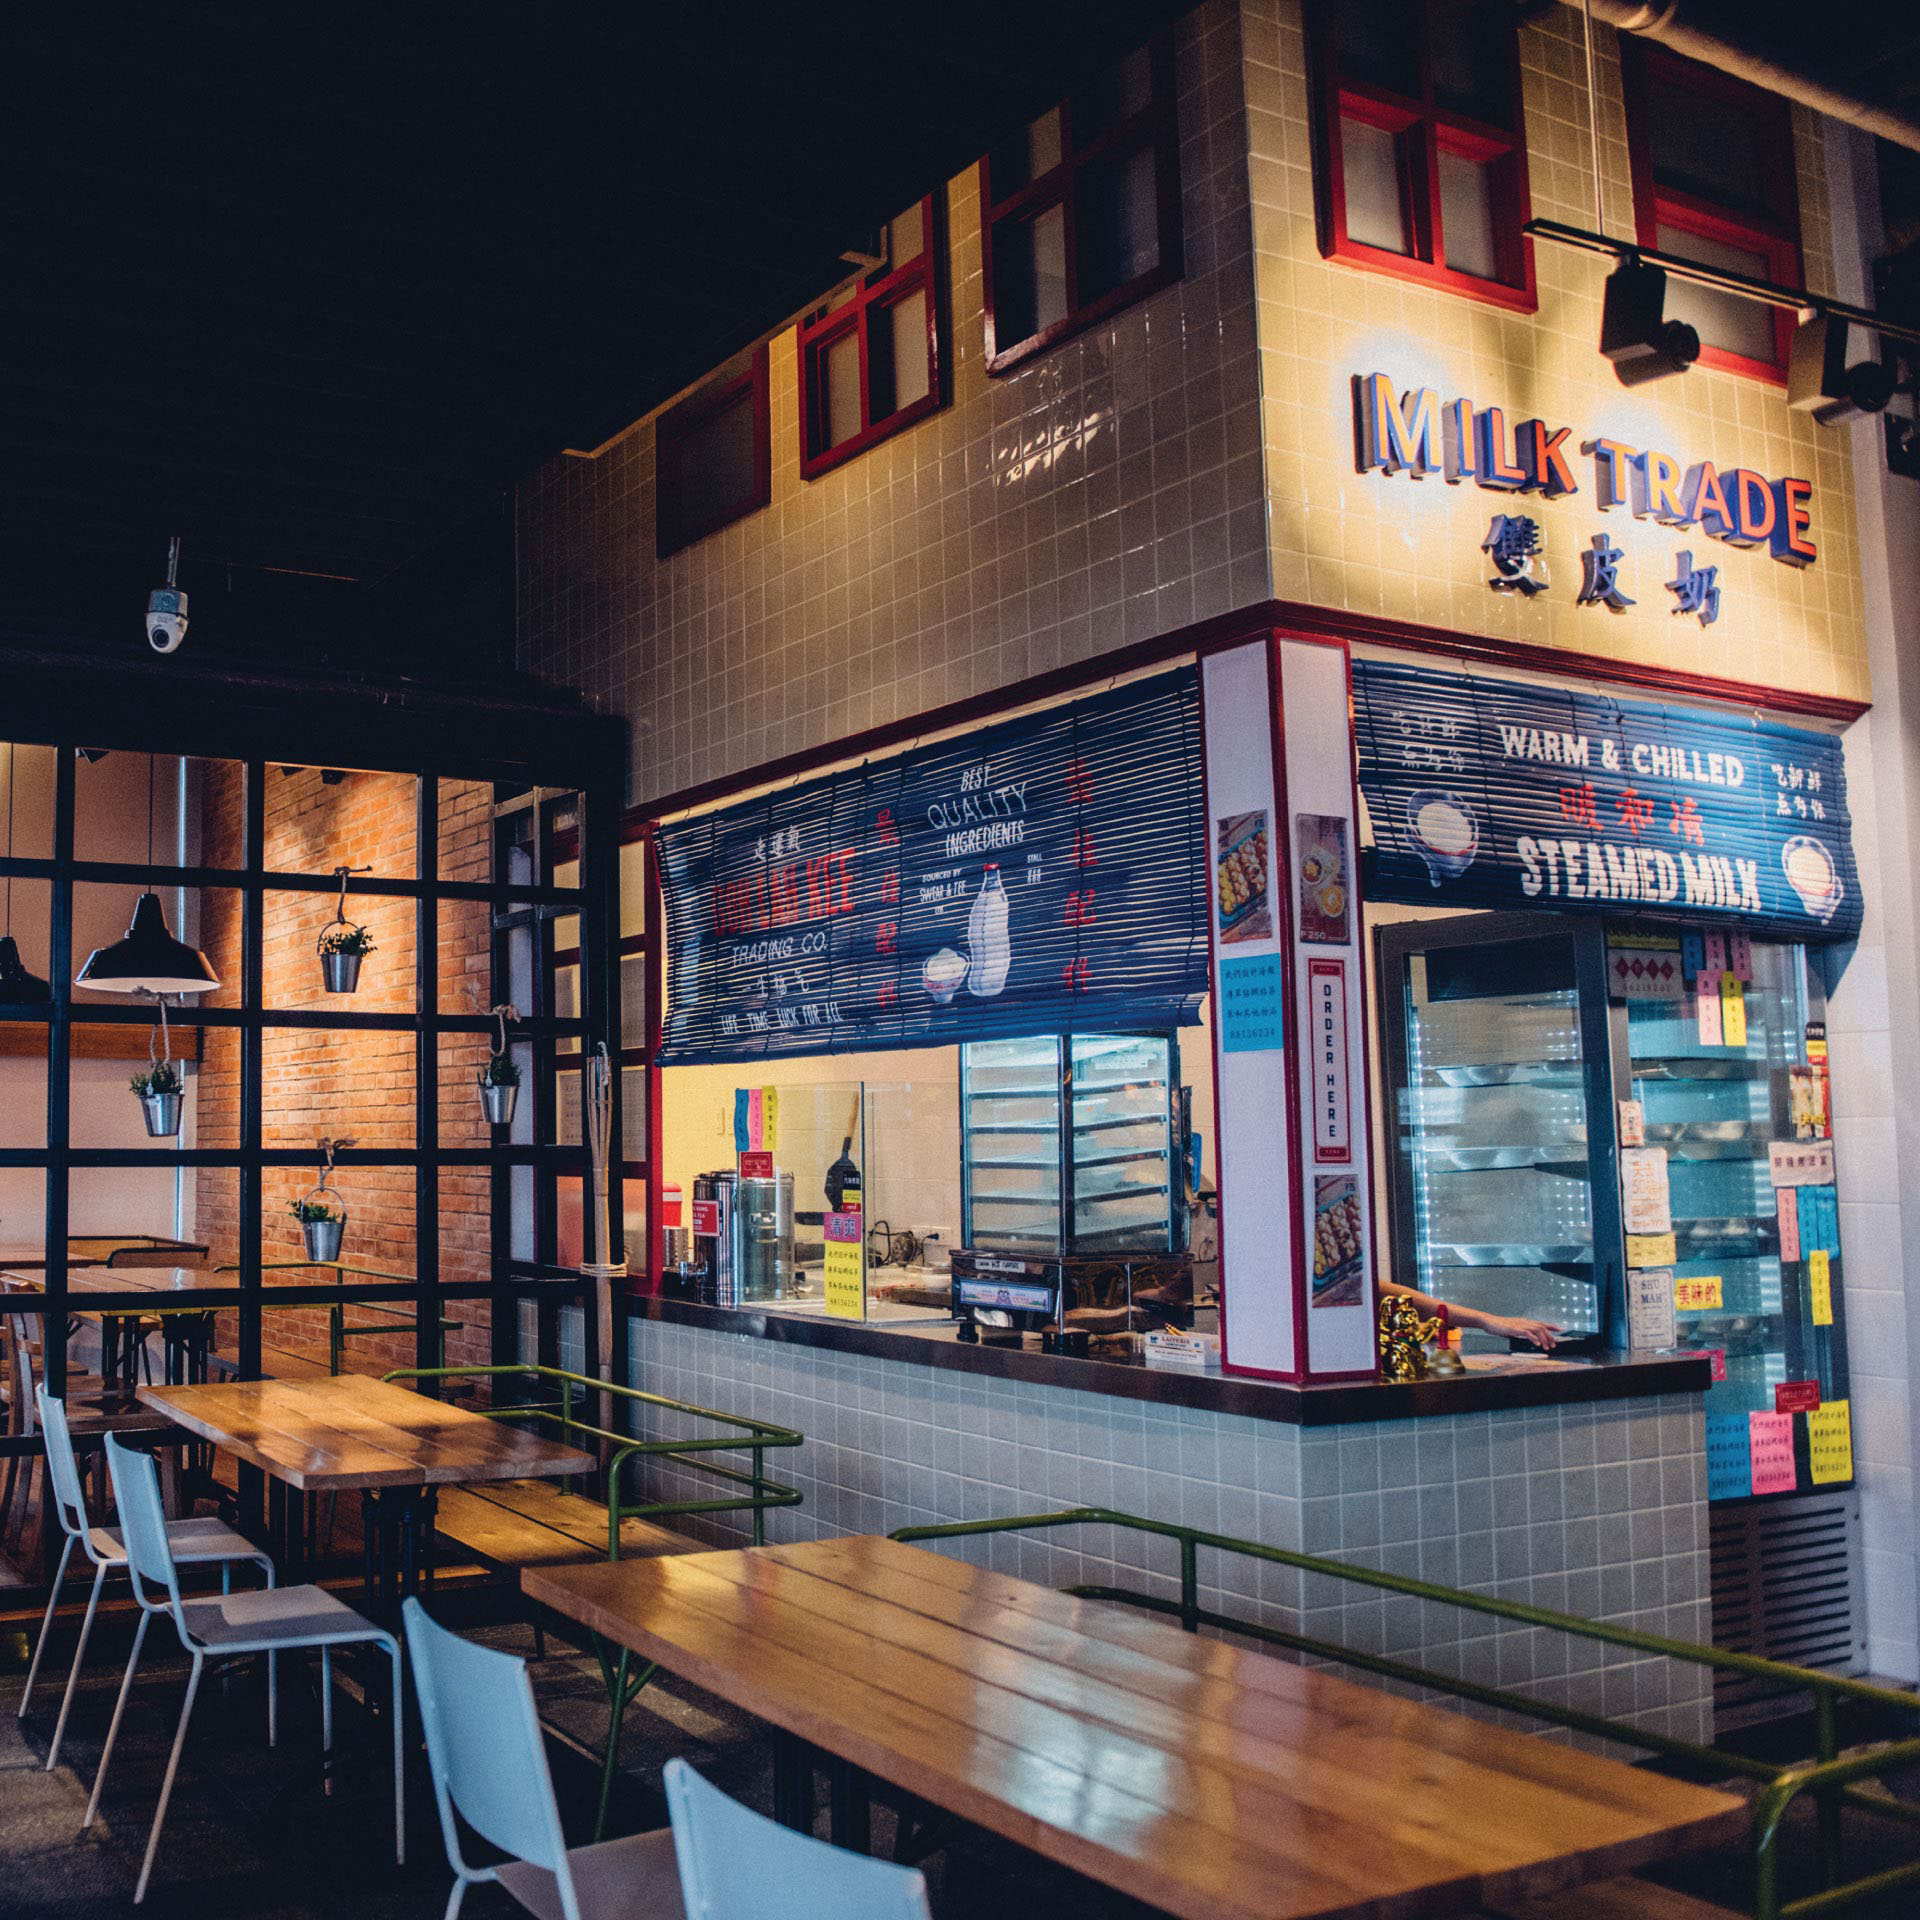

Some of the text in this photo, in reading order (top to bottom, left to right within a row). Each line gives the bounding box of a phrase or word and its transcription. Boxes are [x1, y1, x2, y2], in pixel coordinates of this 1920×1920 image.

[1354, 372, 1817, 569] MILK TRADE
[1500, 725, 1744, 787] WARM & CHILLED
[960, 765, 991, 792] BEST
[927, 782, 1028, 830] QUALITY
[946, 820, 1025, 858] INGREDIENTS
[922, 867, 962, 883] SOURCED BY
[1026, 853, 1043, 864] STALL
[1026, 868, 1042, 884] 888
[1517, 835, 1762, 913] STEAMED MILK
[805, 846, 857, 921] KEE
[732, 931, 829, 967] TRADING CO.
[1308, 930, 1327, 940] 250
[721, 1002, 844, 1035] LIFE TIME LUCK FOR ALL
[1322, 983, 1335, 1065] ORDER
[1326, 1073, 1337, 1138] HERE
[829, 1216, 857, 1238] 清爽
[1678, 1282, 1717, 1305] 美味的
